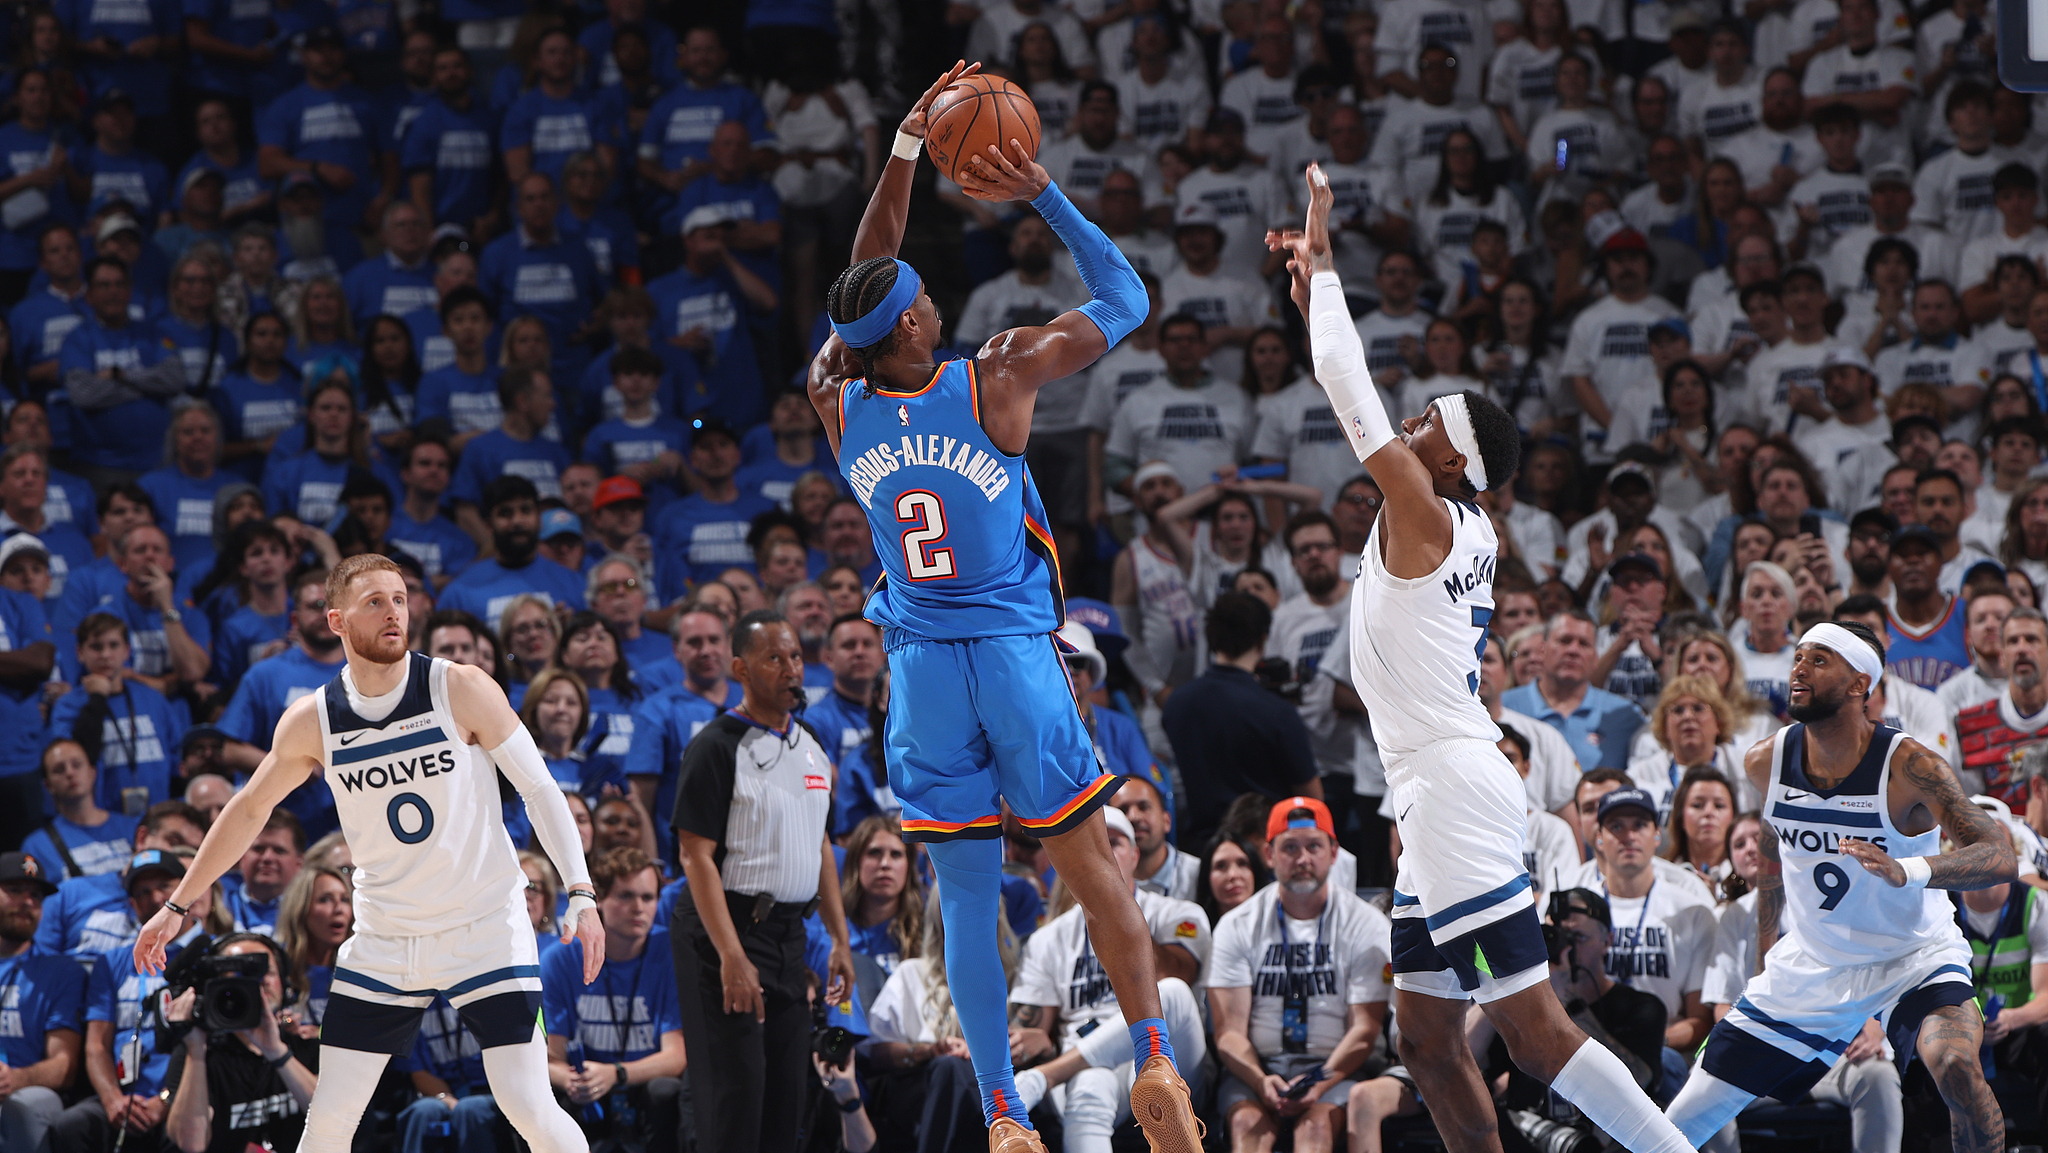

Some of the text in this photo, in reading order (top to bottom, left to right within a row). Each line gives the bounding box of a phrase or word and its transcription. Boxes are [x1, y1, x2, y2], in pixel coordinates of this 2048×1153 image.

[894, 488, 958, 582] 2
[405, 718, 432, 730] sezzle
[338, 750, 456, 794] WOLVES
[387, 792, 434, 844] 0
[1846, 801, 1873, 809] sezzle
[1813, 862, 1850, 911] 9
[230, 1092, 299, 1130] ESPN
